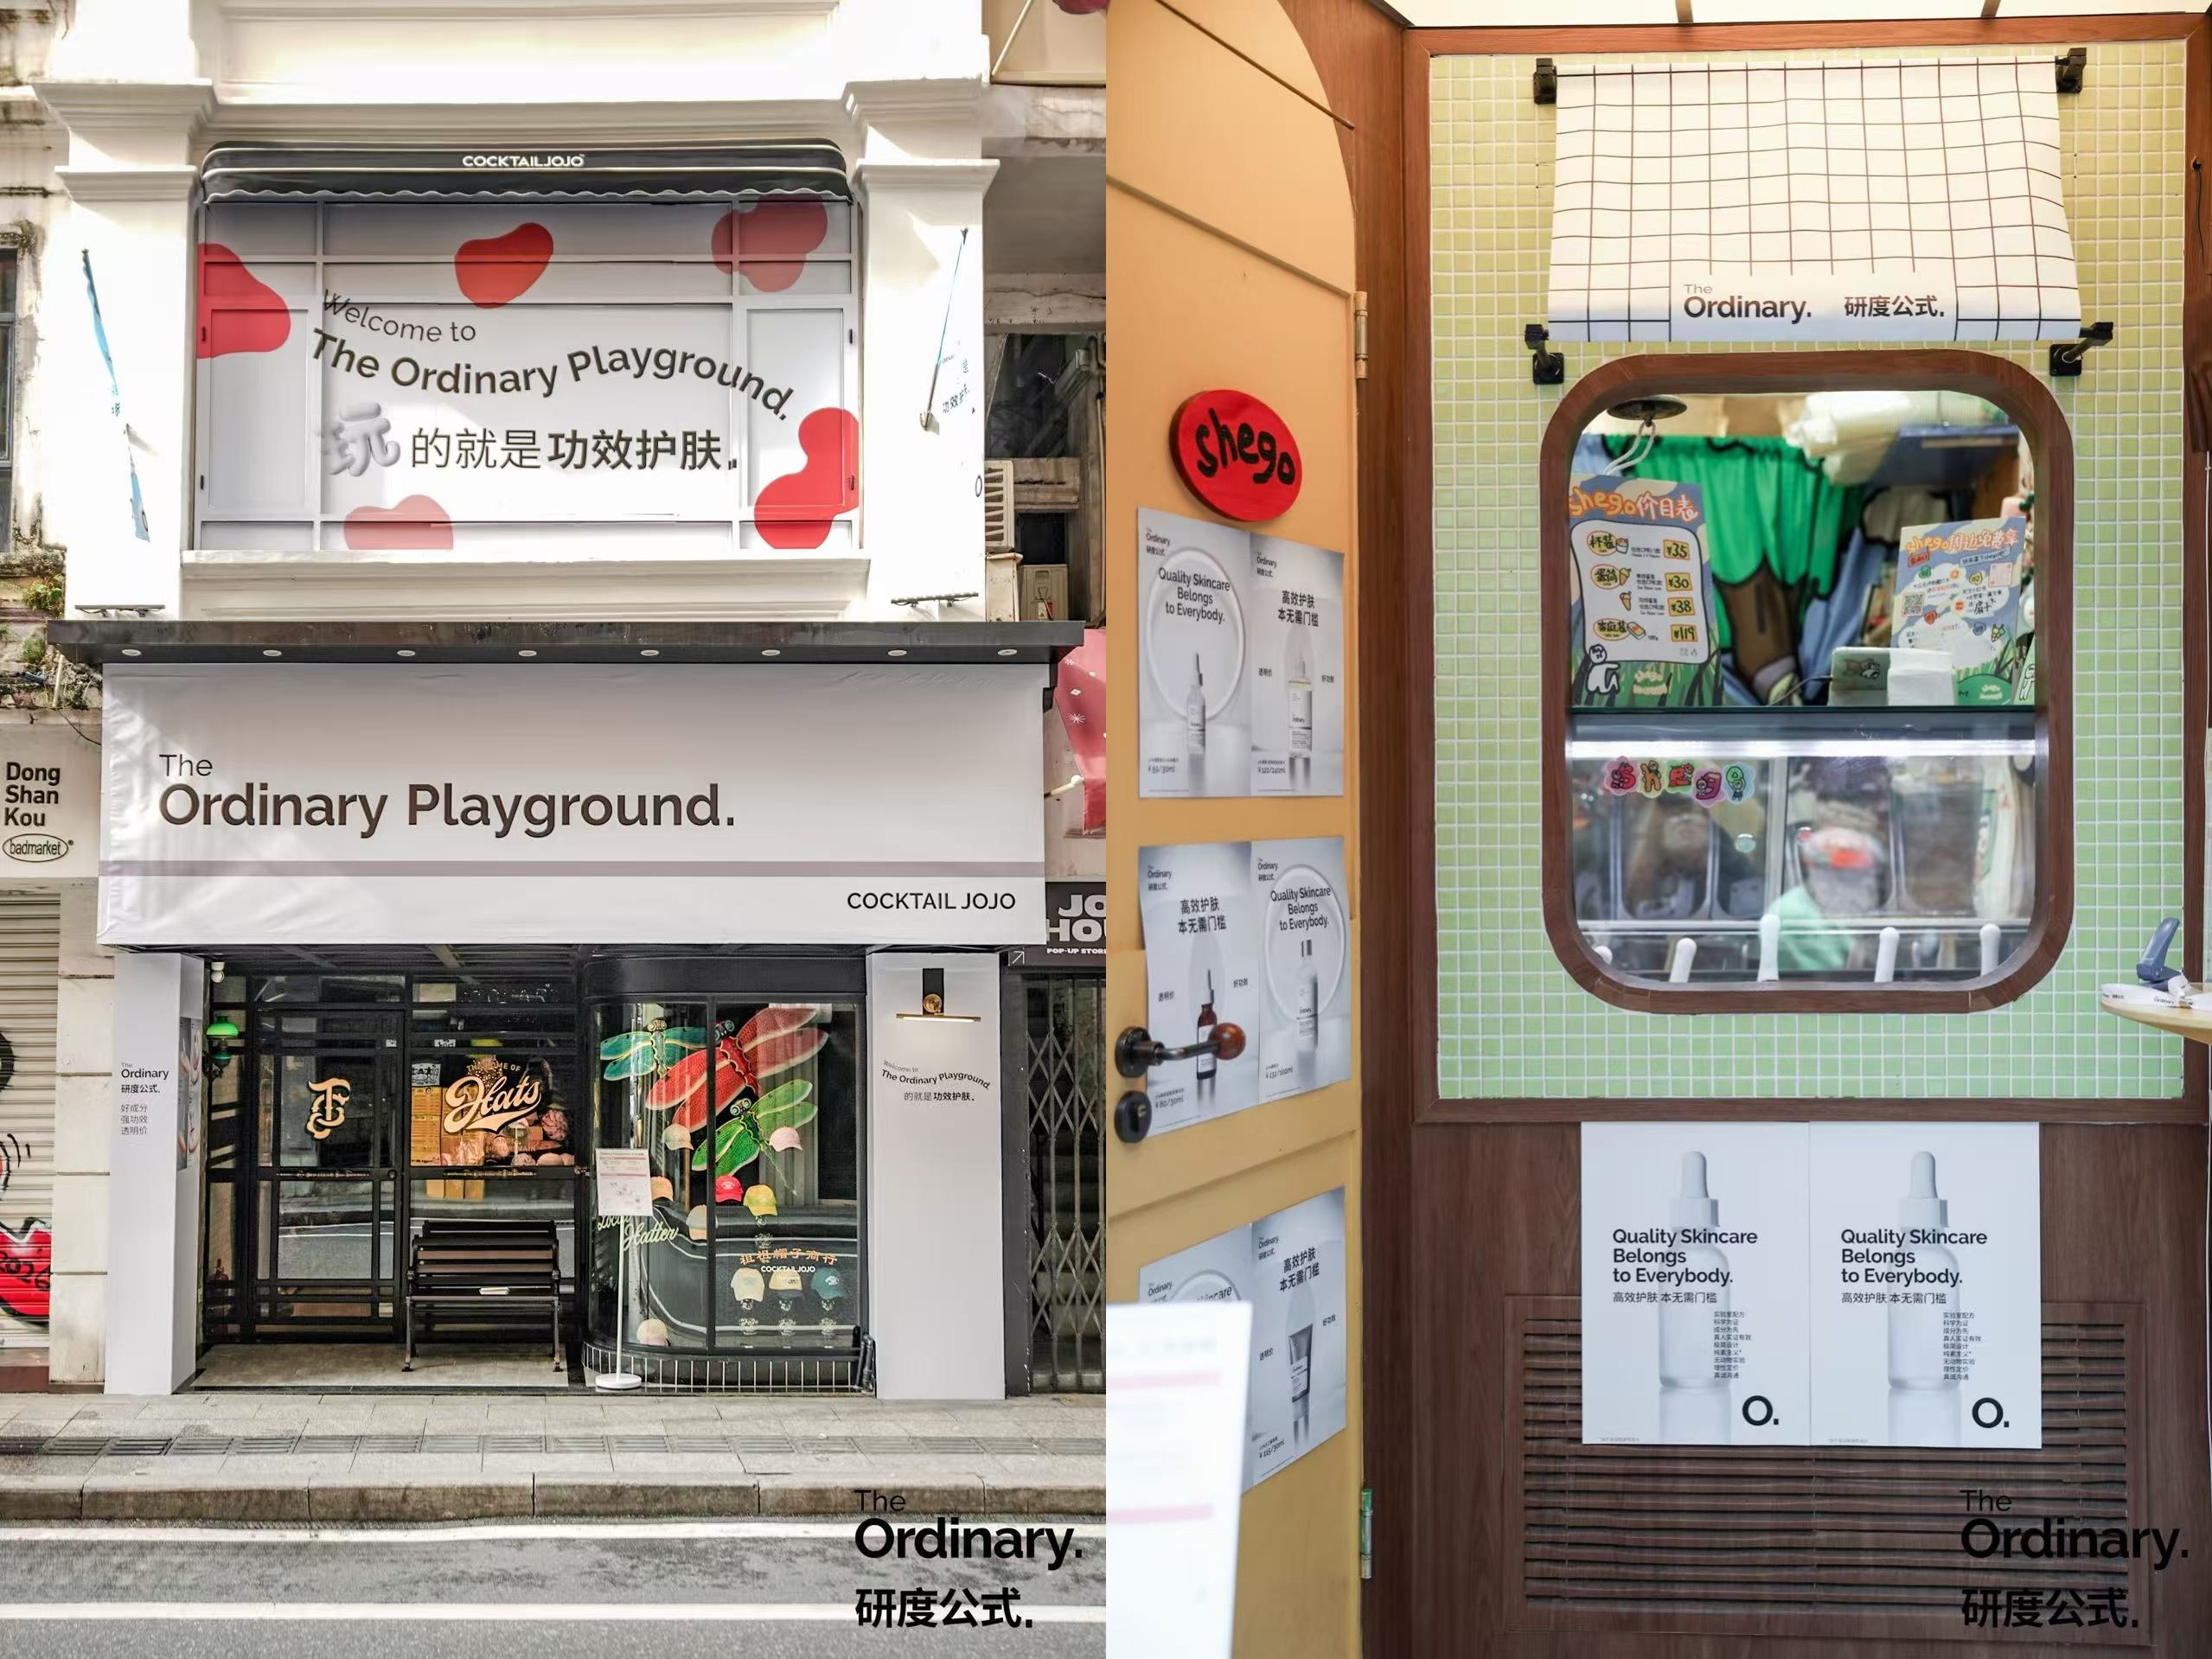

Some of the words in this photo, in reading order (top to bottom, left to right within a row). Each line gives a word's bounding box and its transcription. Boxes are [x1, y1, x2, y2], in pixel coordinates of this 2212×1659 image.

[1684, 284, 1713, 295] The
[324, 290, 442, 342] Welcome
[451, 322, 476, 342] to
[1684, 296, 1812, 325] Ordinary.
[1844, 295, 1945, 318] 研度公式.
[313, 328, 380, 378] The
[391, 356, 558, 398] Ordinary
[567, 345, 794, 421] Playground.
[1666, 542, 1688, 558] ¥35
[1159, 567, 1192, 588] Quality
[1193, 573, 1231, 592] Skincare
[1668, 575, 1690, 589] ¥30
[1177, 587, 1214, 607] Belongs
[1282, 590, 1315, 609] 高效护肤
[1671, 599, 1692, 614] ¥38
[1165, 601, 1175, 616] to
[1177, 603, 1225, 625] Everybody.
[1277, 607, 1319, 628] 本无需门槛
[1673, 626, 1696, 641] ¥119
[6, 762, 61, 786] Dong
[159, 754, 213, 776] The
[5, 784, 59, 804] Shan
[4, 807, 46, 826] Kou
[159, 782, 387, 839] Ordinary
[408, 782, 735, 839] Playground.
[10, 839, 61, 855] badmarket
[847, 892, 956, 909] COCKTAIL
[961, 892, 1016, 909] JOJO
[1270, 888, 1298, 903] Quality
[1299, 886, 1332, 900] Skincare
[1180, 896, 1221, 916] 高效护肤
[1288, 903, 1319, 916] Belongs
[1046, 918, 1106, 941] HO
[1178, 914, 1227, 935] 本无需门槛
[1280, 920, 1288, 931] to
[1288, 914, 1330, 931] Everybody.
[121, 1069, 169, 1080] Ordinary
[884, 1059, 911, 1073] Welcome
[882, 1069, 898, 1081] The
[899, 1075, 937, 1085] Ordinary
[121, 1104, 148, 1113] 好成分
[444, 1075, 543, 1133] Hats
[1613, 1228, 1677, 1247] Quality
[1680, 1228, 1758, 1244] Skincare
[1841, 1228, 1906, 1248] Quality
[1909, 1228, 1987, 1245] Skincare
[1283, 1247, 1316, 1273] 高效护肤
[1613, 1247, 1687, 1267] Belongs
[1841, 1248, 1915, 1267] Belongs
[1279, 1262, 1320, 1292] 本无需门槛
[1613, 1268, 1631, 1283] to
[1636, 1267, 1734, 1287] Everybody.
[1841, 1268, 1859, 1283] to
[1864, 1268, 1963, 1288] Everybody.
[1613, 1292, 1659, 1304] 高效护肤
[1660, 1292, 1718, 1304] 本无需门槛
[1841, 1292, 1887, 1305] 高效护肤
[1889, 1292, 1947, 1305] 本无需门槛
[1742, 1394, 1780, 1426] O.
[1972, 1396, 2010, 1429] O.
